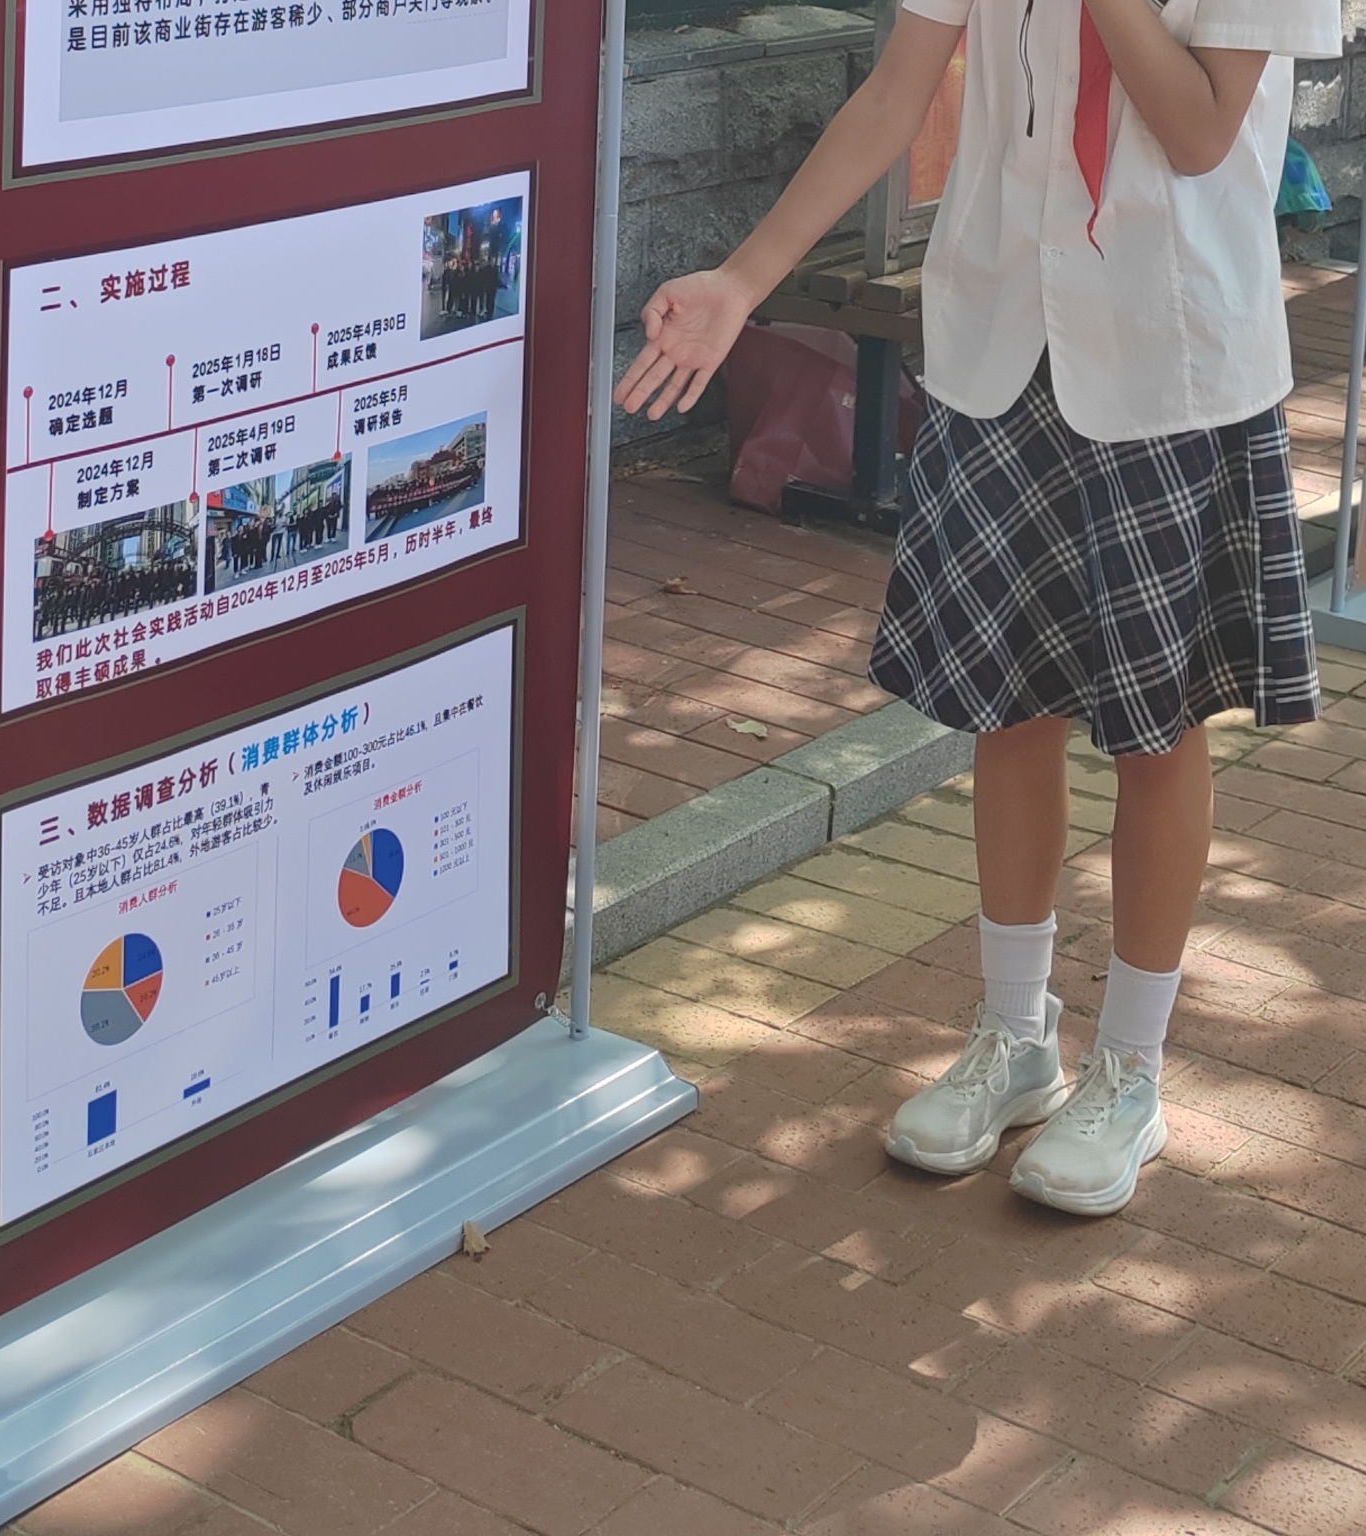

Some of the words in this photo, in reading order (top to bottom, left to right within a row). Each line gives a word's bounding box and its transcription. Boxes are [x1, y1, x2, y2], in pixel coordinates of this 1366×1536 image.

[40, 260, 191, 312] 二、实施过程
[326, 313, 407, 346] 2025年4月30日
[191, 343, 282, 378] 2025年1月18日
[326, 342, 377, 371] 成果反馈
[48, 379, 128, 411] 2024年12月
[191, 371, 263, 405] 第一次调研
[353, 385, 409, 413] 2025年5月
[48, 407, 113, 437] 确定选题
[207, 415, 296, 452] 2025年4月19日
[353, 408, 403, 436] 调研报告
[76, 450, 154, 484] 2024年12月
[207, 443, 277, 478] 第二次调研
[76, 479, 140, 510] 制定方案
[35, 650, 164, 701] 取得丰硕成果。
[38, 700, 371, 847] 三、数据调查分析（消费群体分析）
[373, 780, 423, 811] 消费金额分析
[117, 879, 178, 915] 消费人群分析
